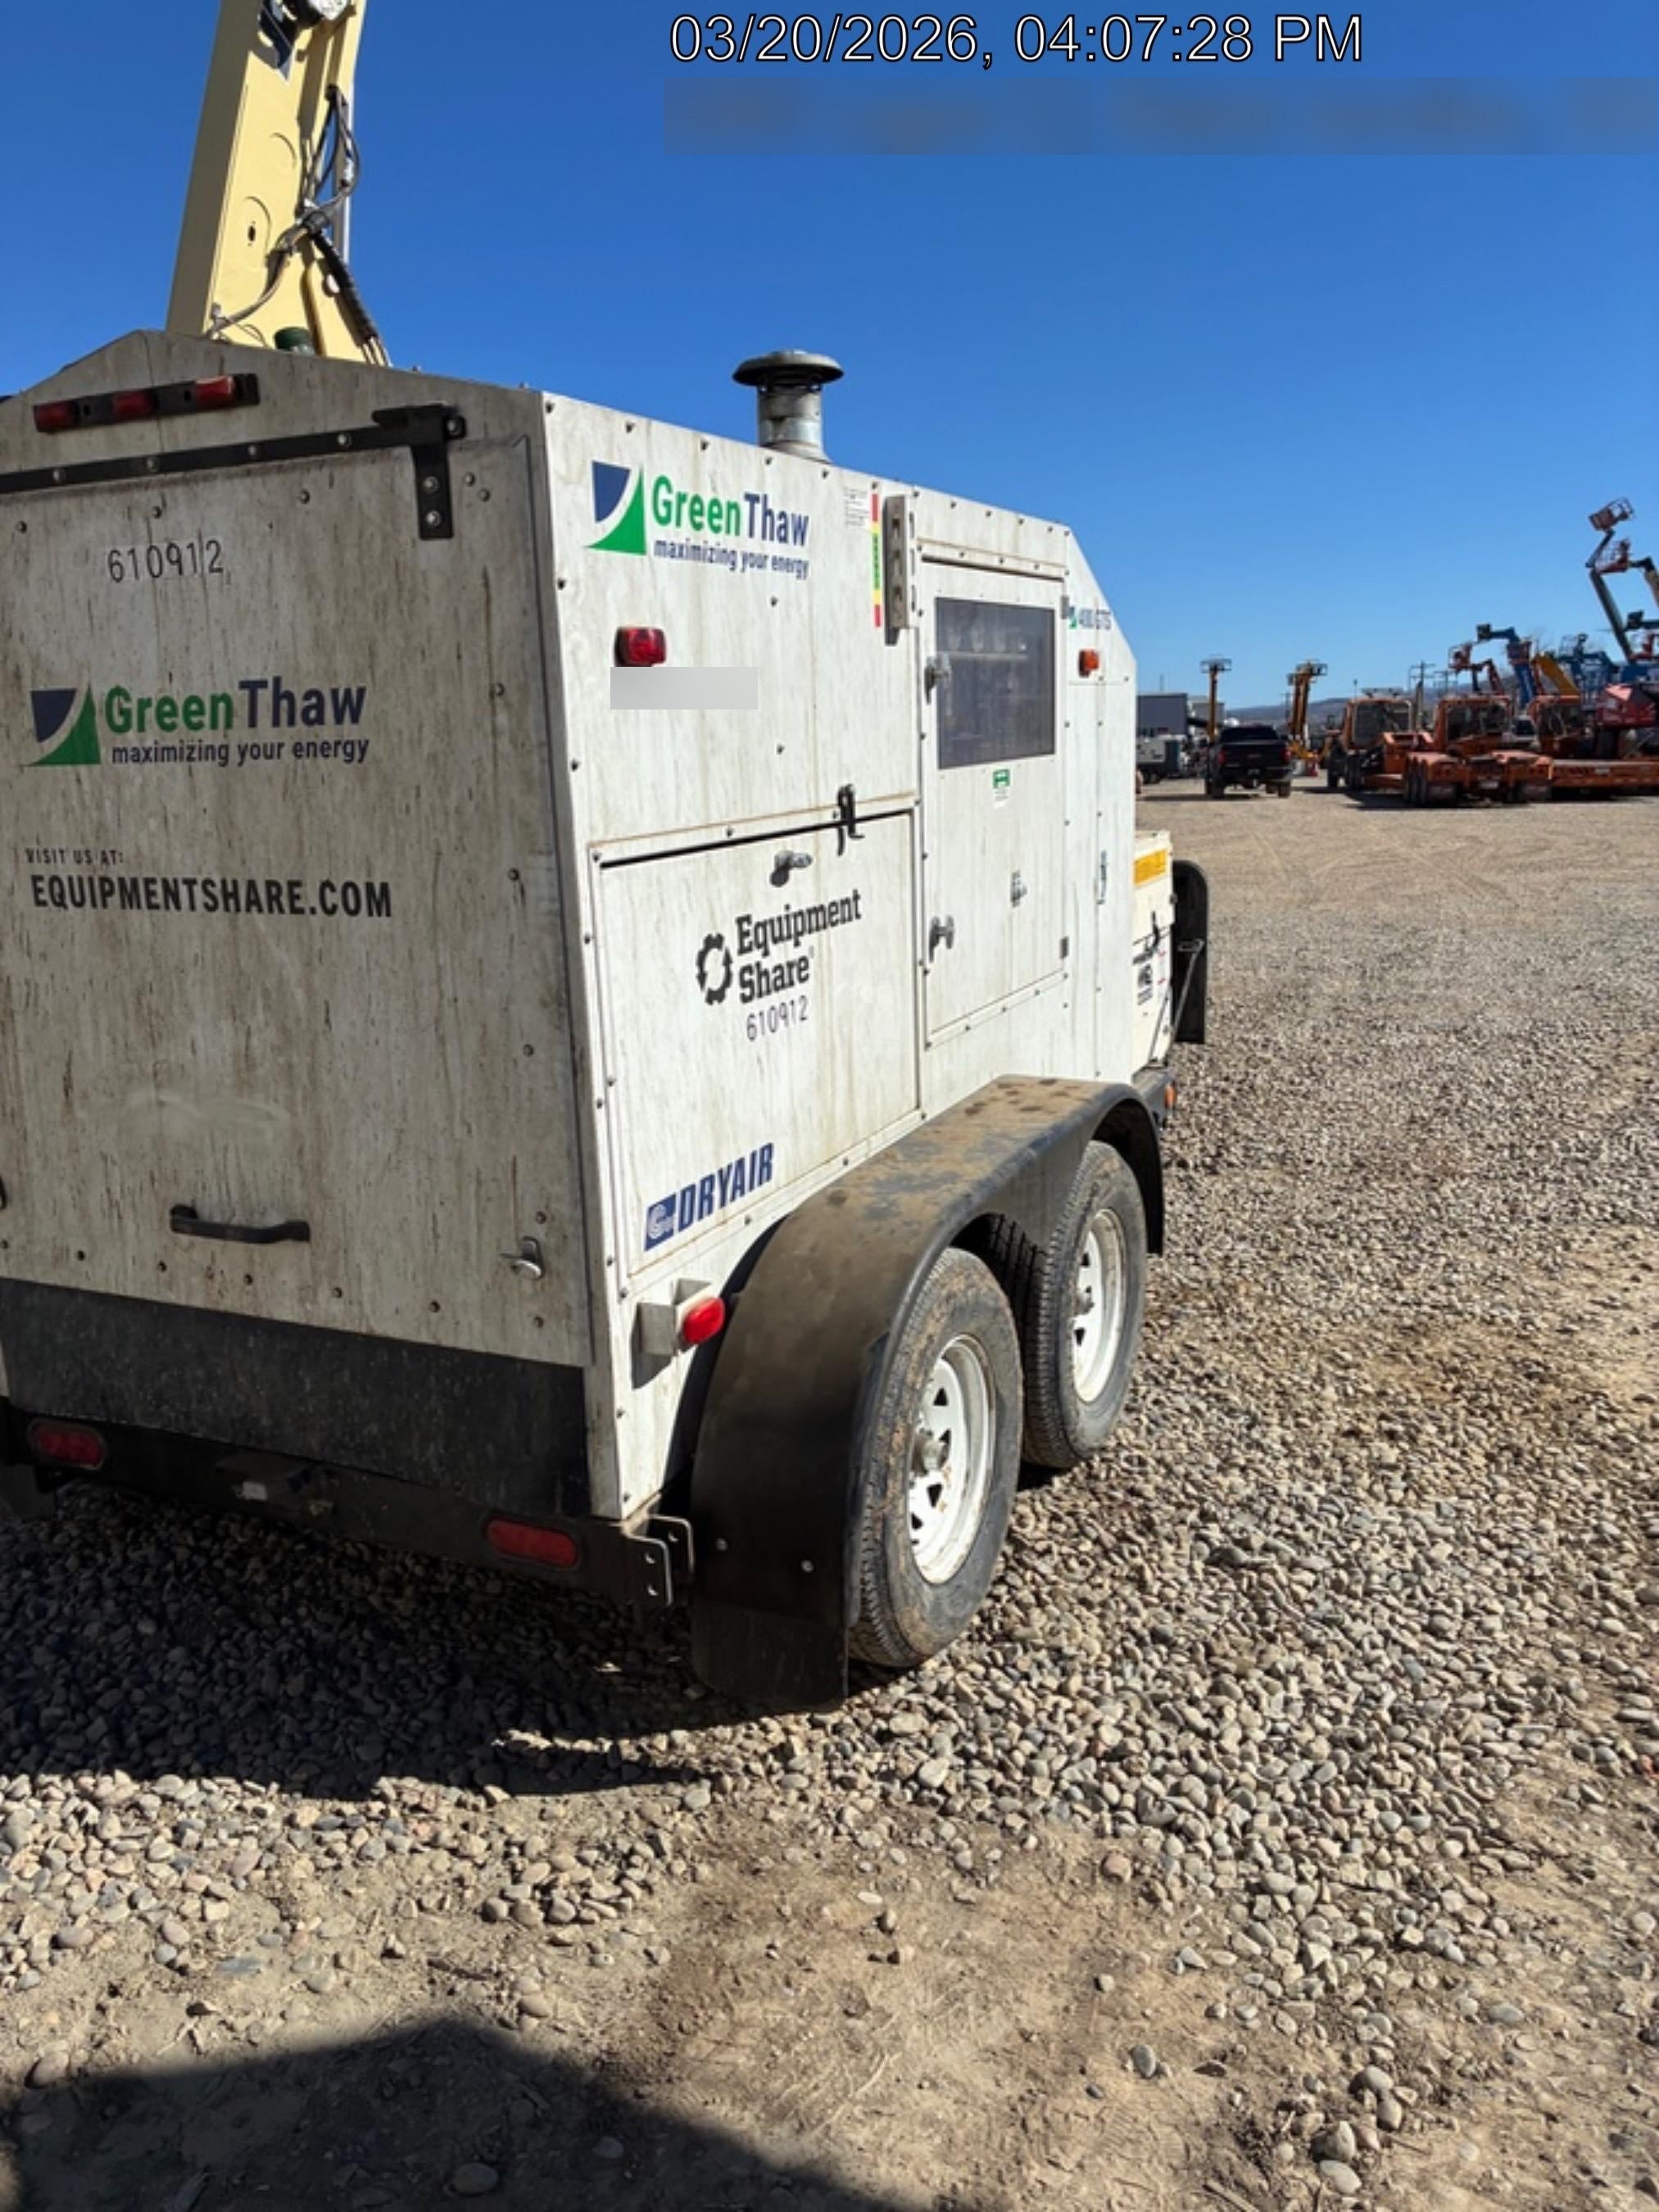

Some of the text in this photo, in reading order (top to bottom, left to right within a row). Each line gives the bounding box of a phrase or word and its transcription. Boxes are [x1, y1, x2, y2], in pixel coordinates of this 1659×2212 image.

[107, 539, 224, 583] 610912
[654, 537, 810, 581] maximizing your energy
[111, 737, 370, 767] maximizing your energy
[25, 847, 124, 865] VISIT US AT:
[30, 873, 393, 918] EQUIPMENTSHARE.COM
[735, 888, 862, 959] Equipment
[738, 954, 810, 1004] Share
[746, 994, 808, 1042] 610912
[677, 1141, 774, 1233] DRYAIR
